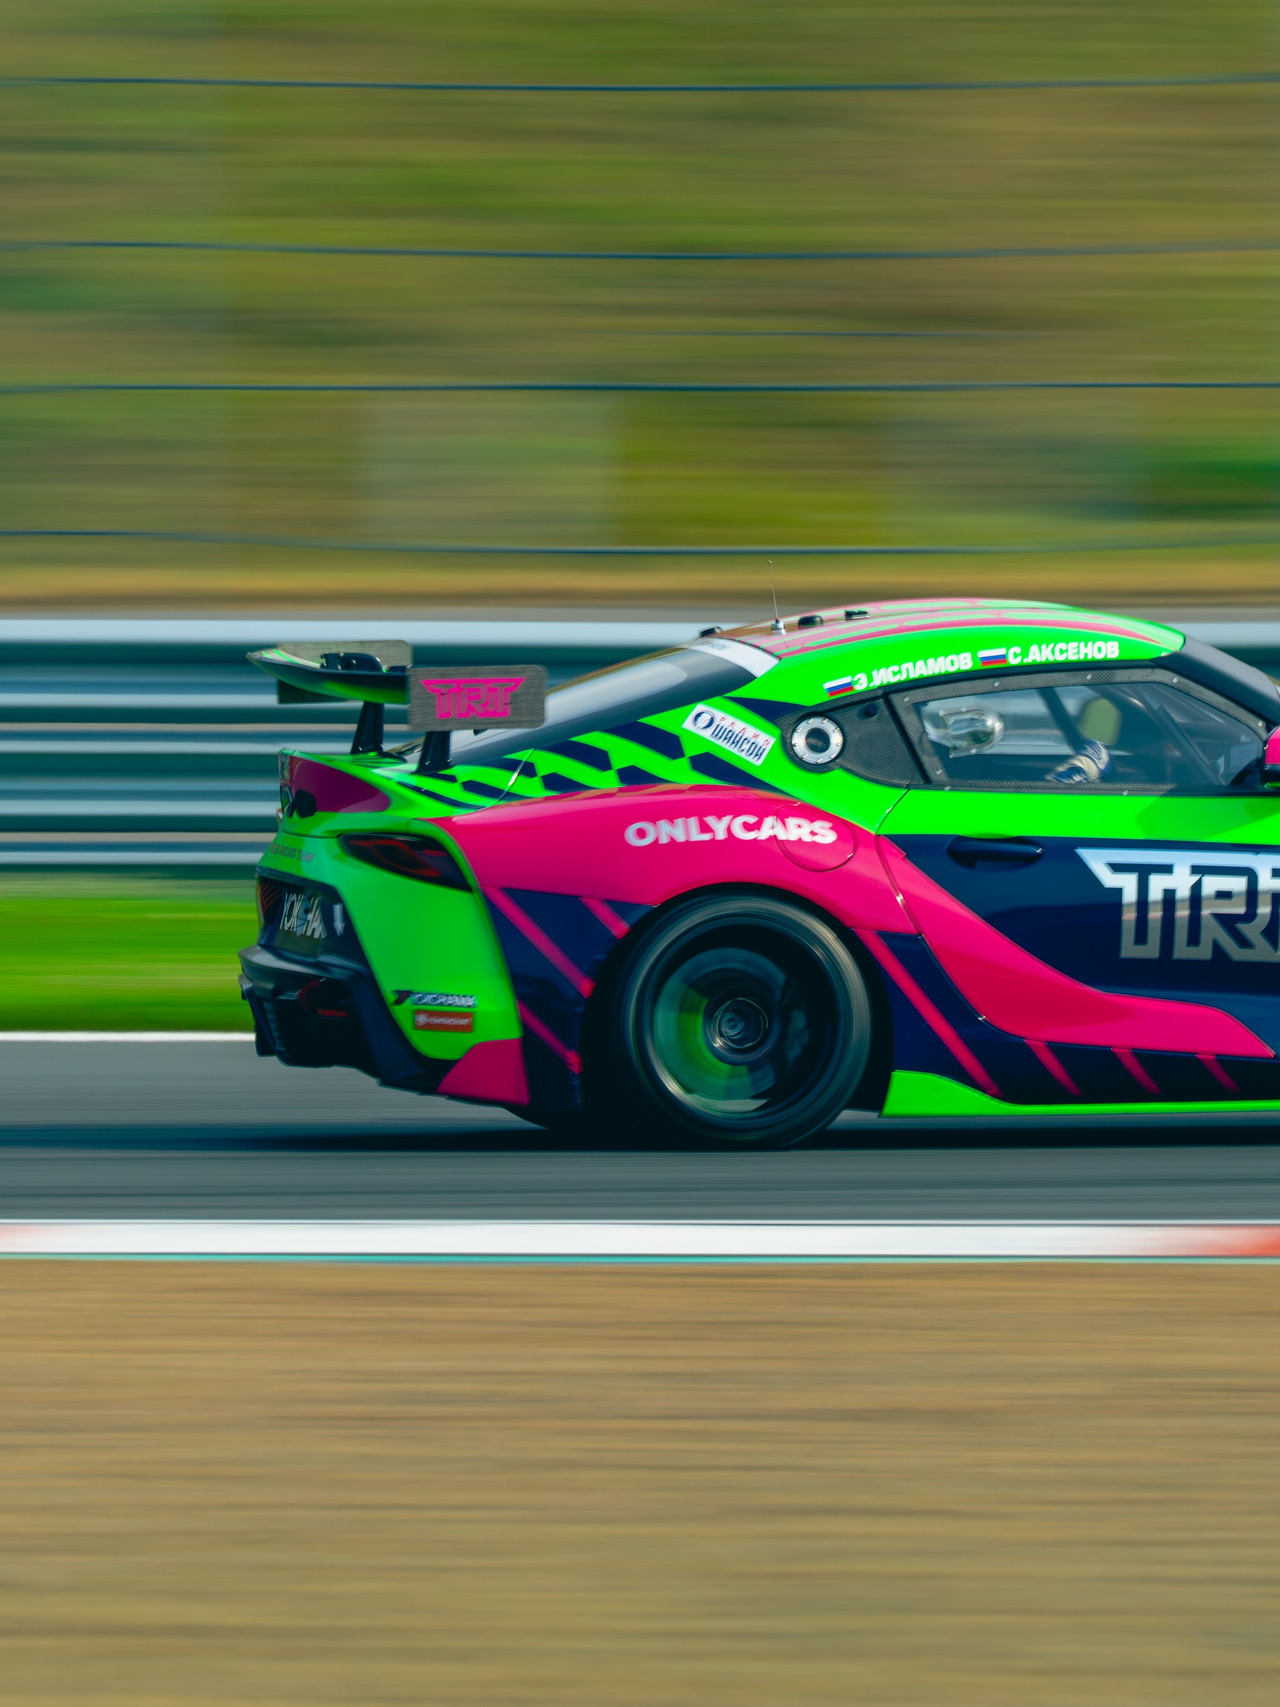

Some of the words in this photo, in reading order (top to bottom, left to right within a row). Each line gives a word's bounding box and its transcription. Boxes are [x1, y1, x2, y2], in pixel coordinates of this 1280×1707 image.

[1008, 640, 1120, 665] С.АКСЕНОВ
[853, 652, 973, 691] Э.ИСЛАМОВ
[419, 676, 528, 719] TRT
[624, 814, 838, 847] ONLYCARS
